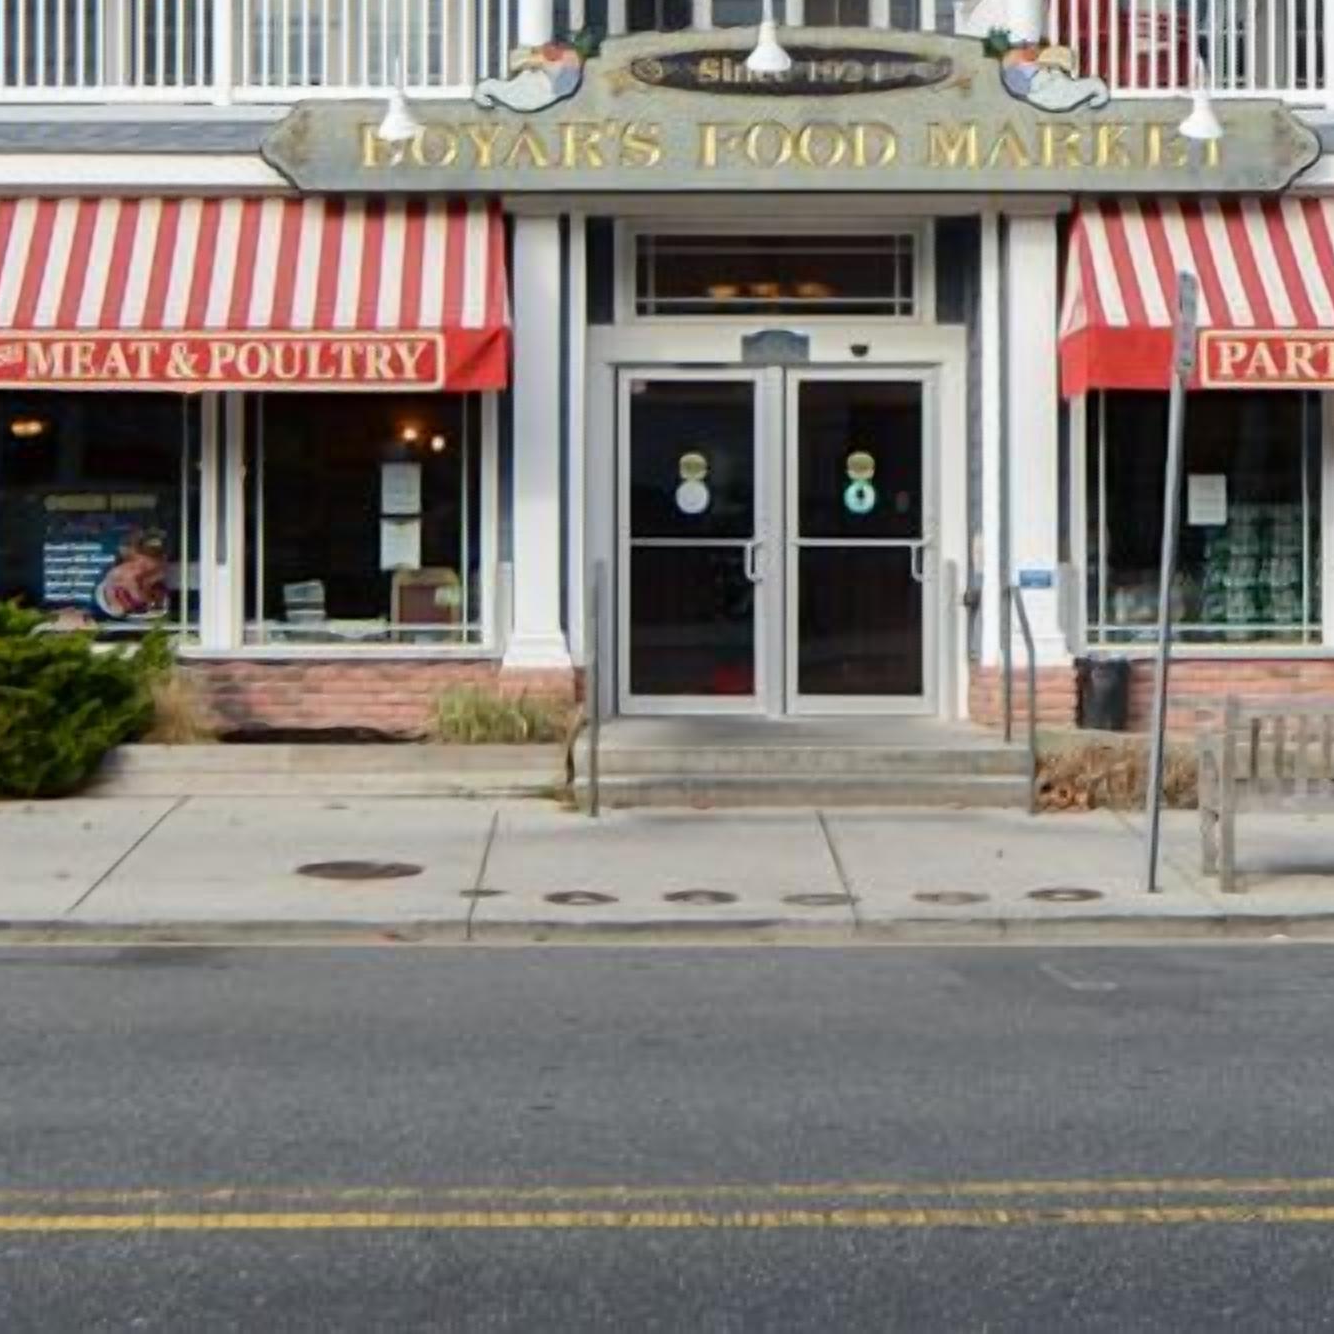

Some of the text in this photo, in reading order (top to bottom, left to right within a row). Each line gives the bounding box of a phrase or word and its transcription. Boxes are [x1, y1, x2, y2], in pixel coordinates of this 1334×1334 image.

[697, 119, 898, 168] FOOD
[27, 340, 160, 379] MEAT
[166, 340, 199, 379] &
[207, 340, 428, 379] POULTRY
